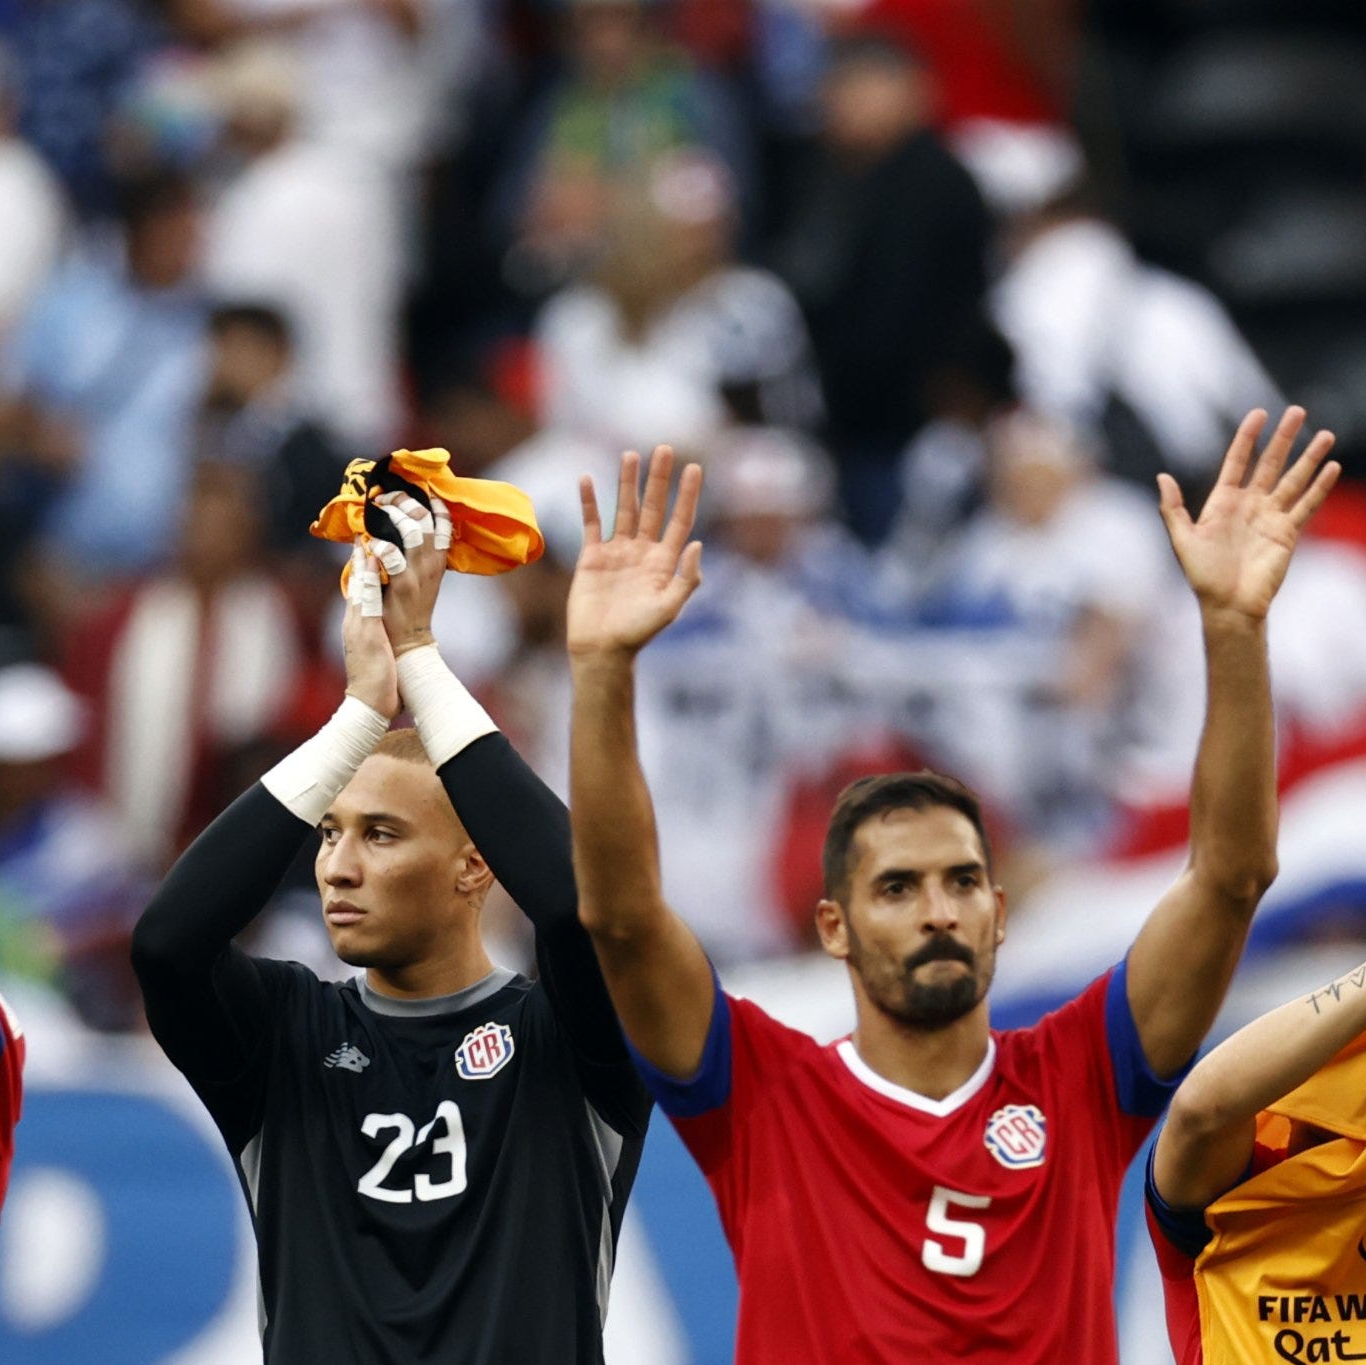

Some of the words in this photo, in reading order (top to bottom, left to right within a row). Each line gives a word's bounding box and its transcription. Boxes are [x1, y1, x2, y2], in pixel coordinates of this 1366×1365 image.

[468, 1033, 501, 1069] CR
[357, 1100, 467, 1203] 23
[921, 1185, 992, 1277] 5
[1258, 1295, 1331, 1323] FIFA
